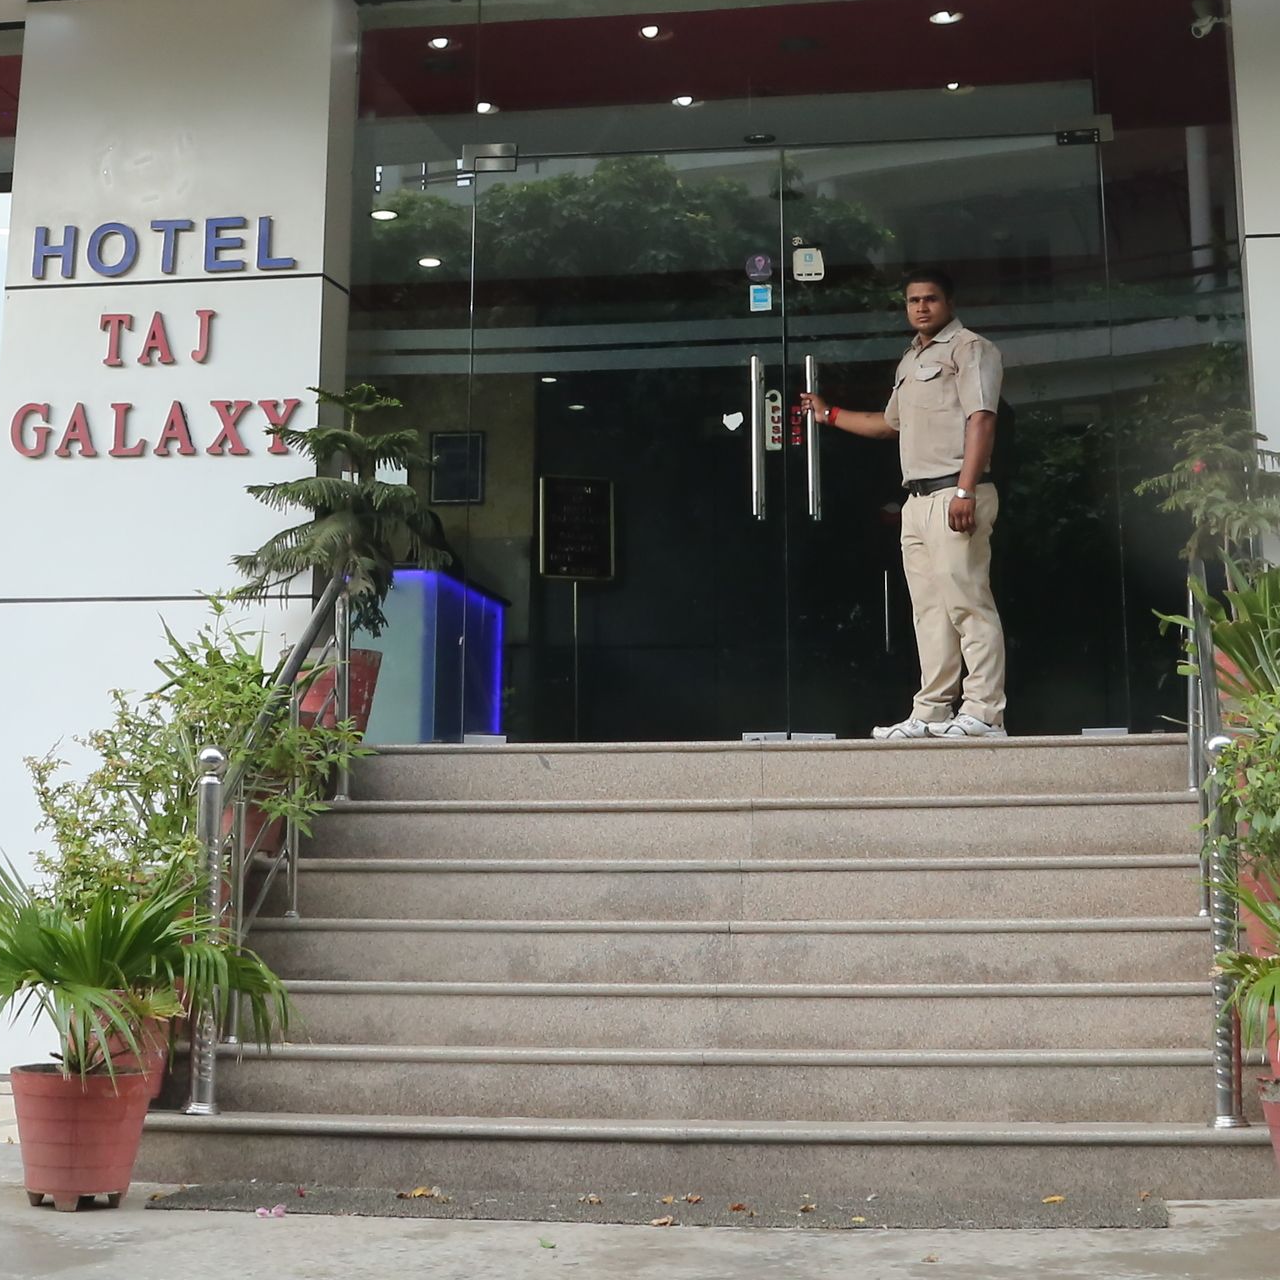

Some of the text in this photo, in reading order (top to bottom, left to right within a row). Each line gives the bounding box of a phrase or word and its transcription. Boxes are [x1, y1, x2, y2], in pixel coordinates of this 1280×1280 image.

[31, 216, 298, 280] HOTEL
[99, 309, 217, 367] TAJ
[10, 398, 302, 459] GALAXY
[771, 405, 783, 445] PUSH
